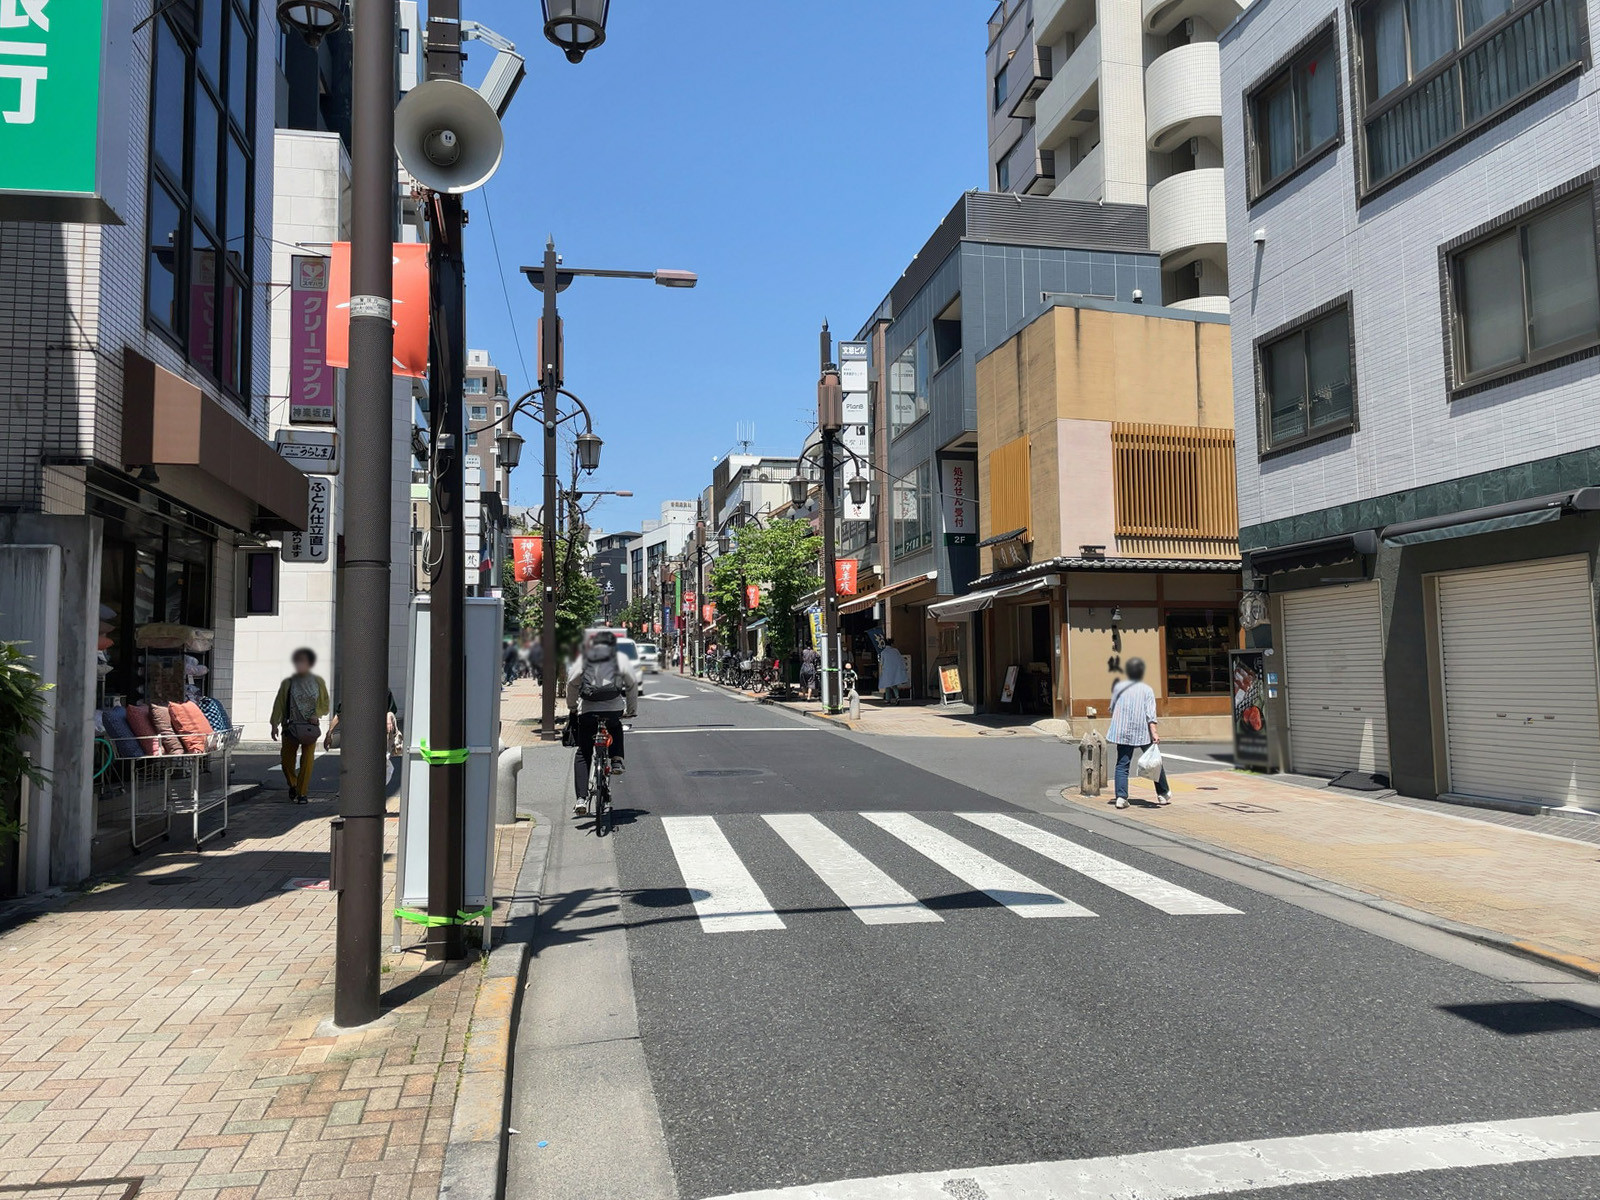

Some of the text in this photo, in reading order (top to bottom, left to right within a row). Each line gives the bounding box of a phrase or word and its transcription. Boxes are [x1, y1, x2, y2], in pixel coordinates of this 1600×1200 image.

[303, 297, 322, 400] クリーニング
[293, 407, 331, 418] 神楽坂店
[300, 446, 328, 457] うらしま
[953, 466, 964, 528] 処方せん受付
[310, 482, 326, 557] ふとん仕立直し
[518, 540, 538, 578] 神楽坂
[954, 536, 966, 544] 2F
